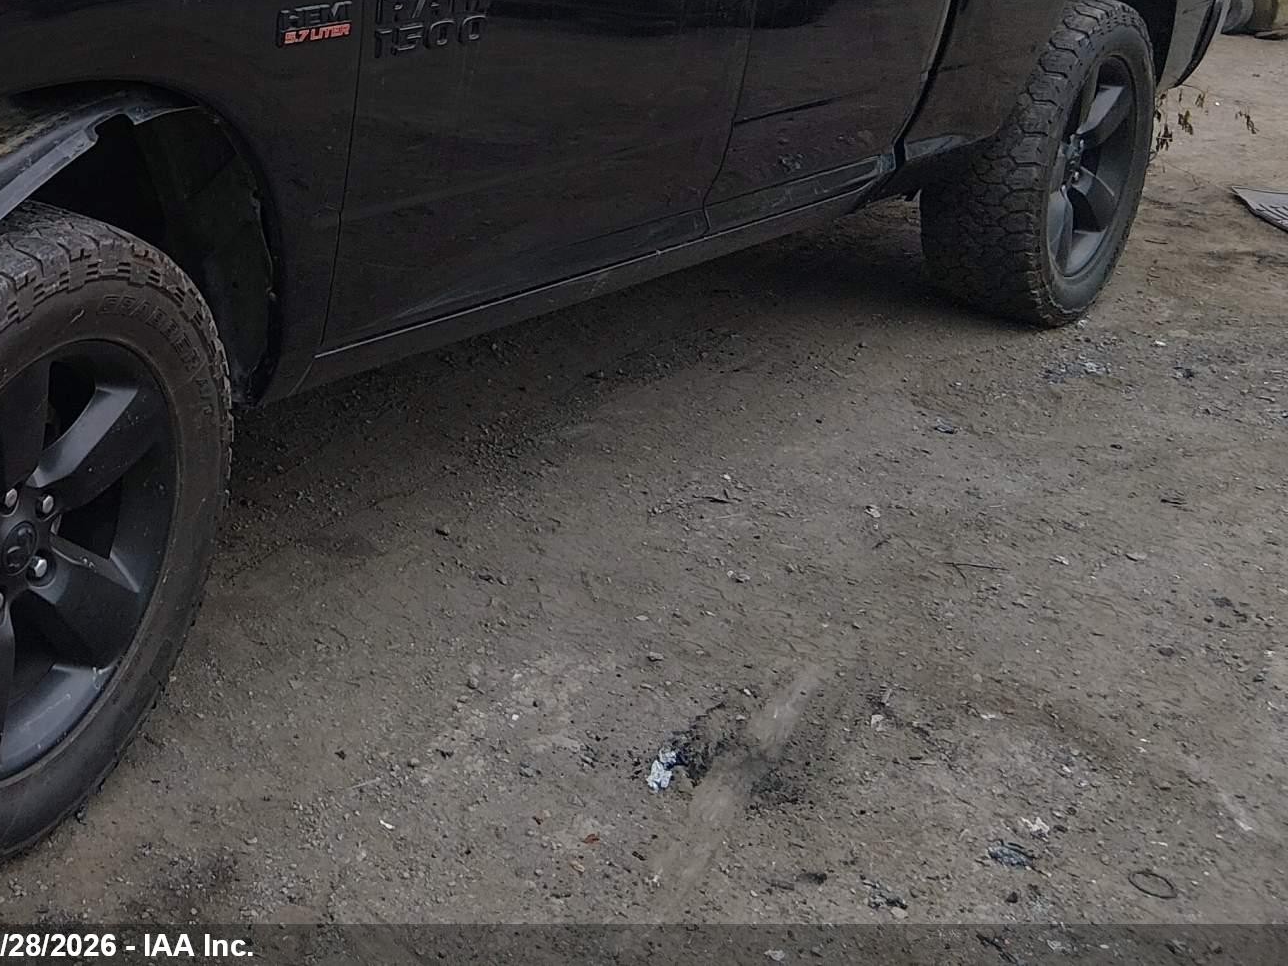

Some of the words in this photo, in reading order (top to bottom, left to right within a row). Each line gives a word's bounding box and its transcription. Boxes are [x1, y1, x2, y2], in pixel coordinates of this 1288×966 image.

[284, 29, 310, 45] 5.7
[309, 23, 351, 41] LITER
[374, 14, 487, 58] 1500
